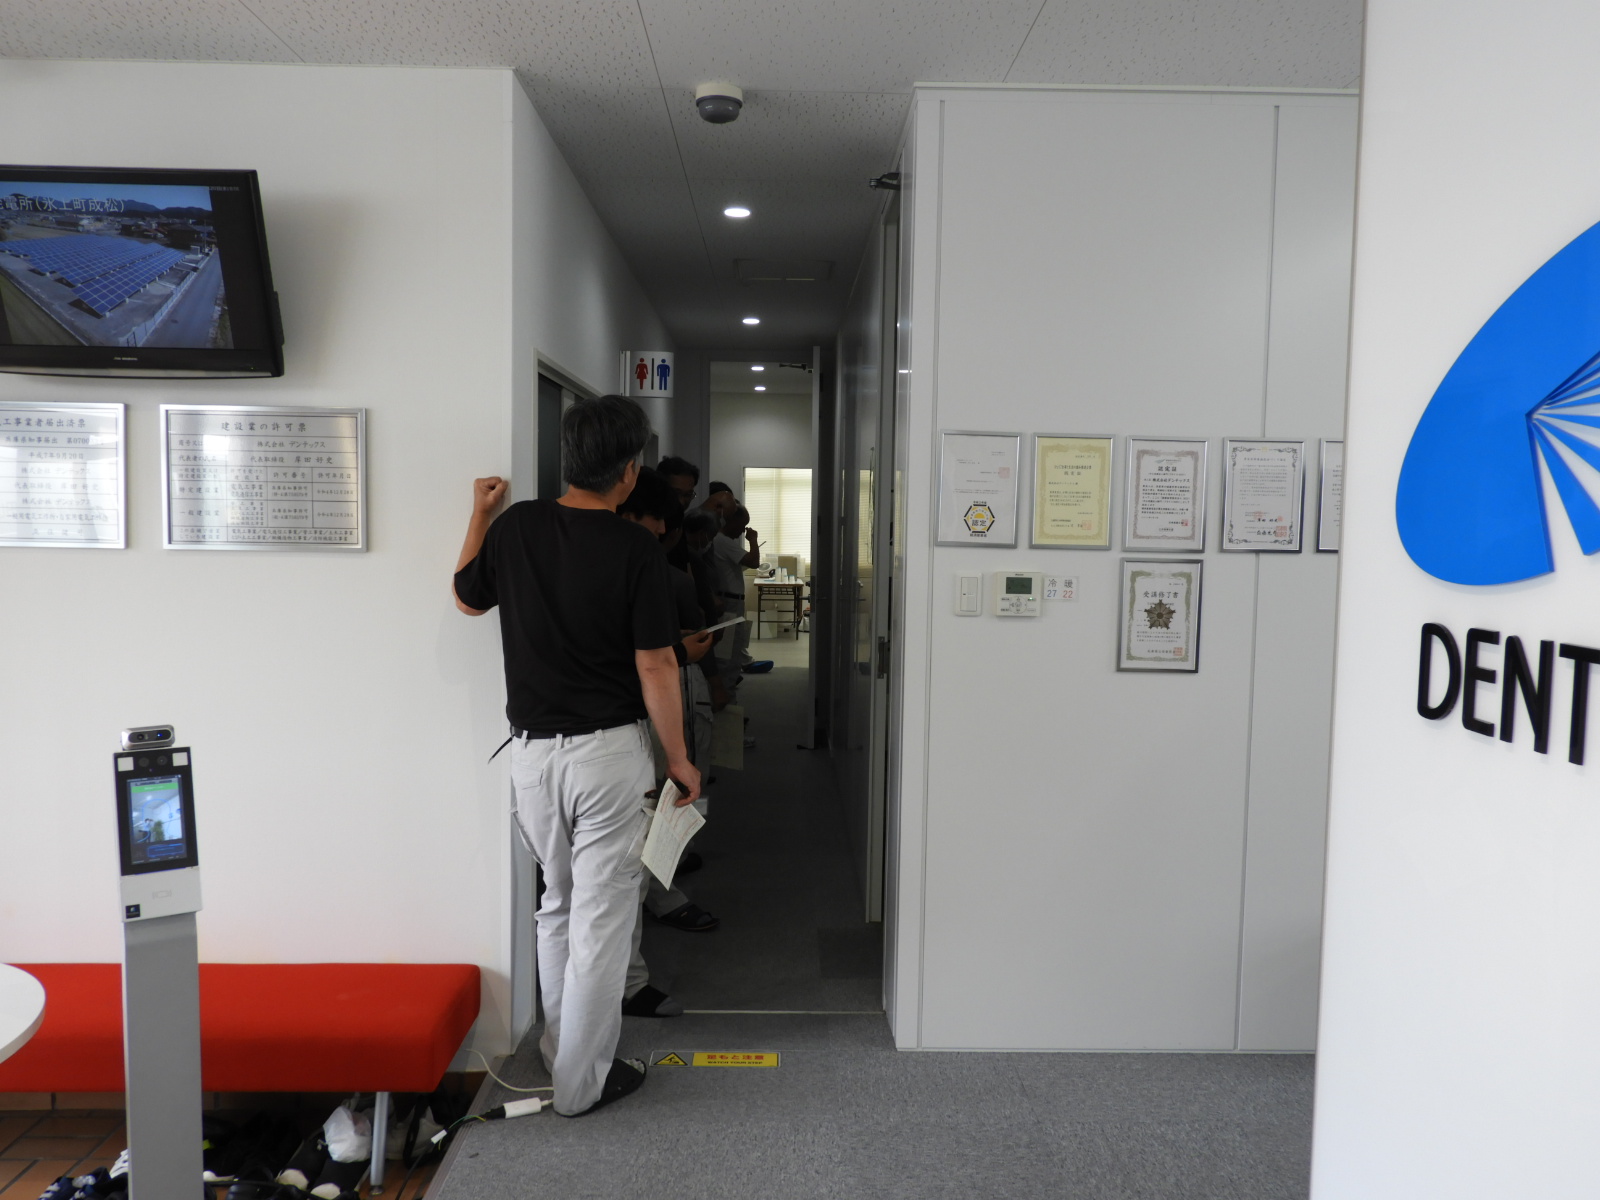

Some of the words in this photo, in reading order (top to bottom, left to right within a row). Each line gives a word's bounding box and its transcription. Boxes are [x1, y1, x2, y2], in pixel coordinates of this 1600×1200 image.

[0, 196, 125, 212] 電所(氷上町成松)
[0, 417, 86, 428] 工事業者届出済票
[221, 421, 307, 432] 建設業の許可票
[178, 439, 210, 447] 商号又は
[289, 440, 326, 448] デンテックス
[1047, 578, 1058, 588] 冷
[1063, 579, 1074, 589] 暖
[1046, 589, 1057, 598] 27
[1062, 590, 1074, 599] 22
[1417, 622, 1600, 766] DENT
